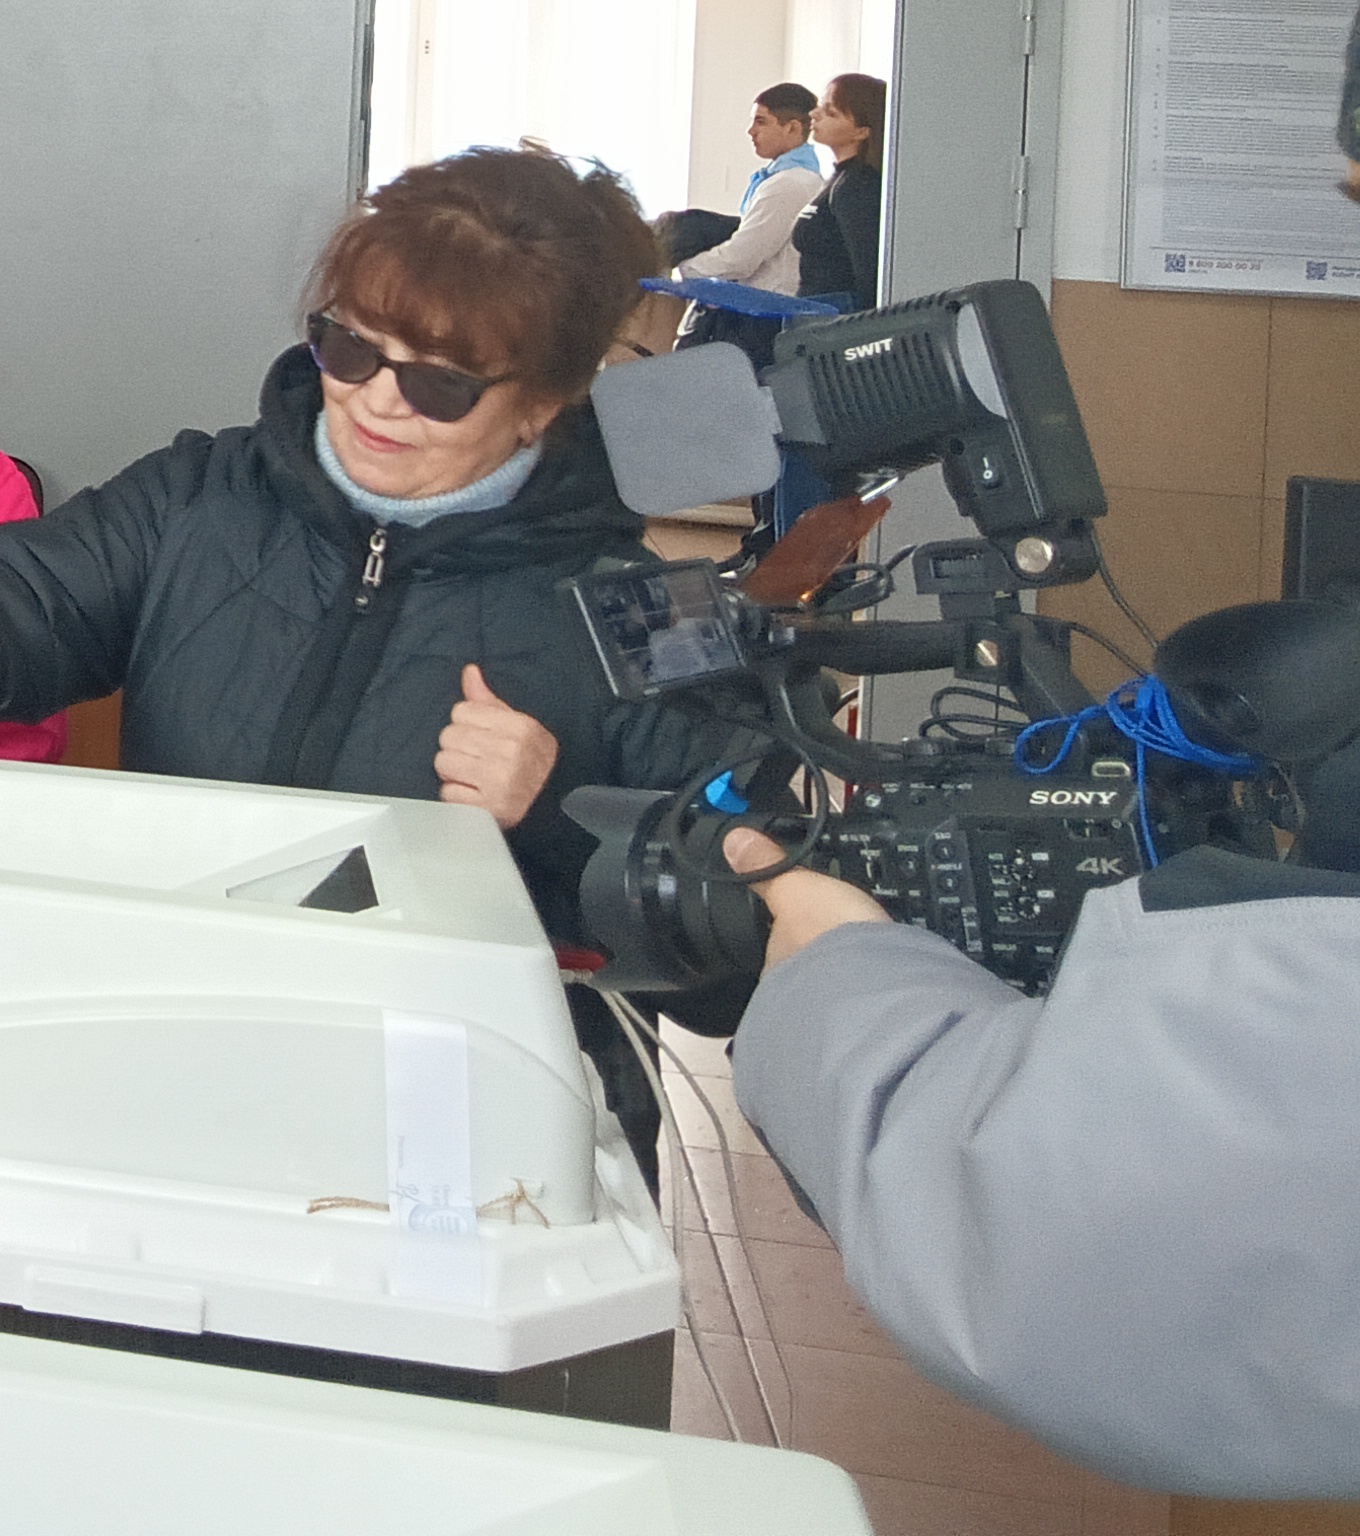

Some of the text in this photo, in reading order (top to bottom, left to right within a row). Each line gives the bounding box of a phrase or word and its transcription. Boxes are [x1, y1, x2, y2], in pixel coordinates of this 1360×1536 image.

[843, 338, 893, 362] SWIT
[1029, 790, 1118, 806] SONY
[1076, 857, 1126, 876] 4K
